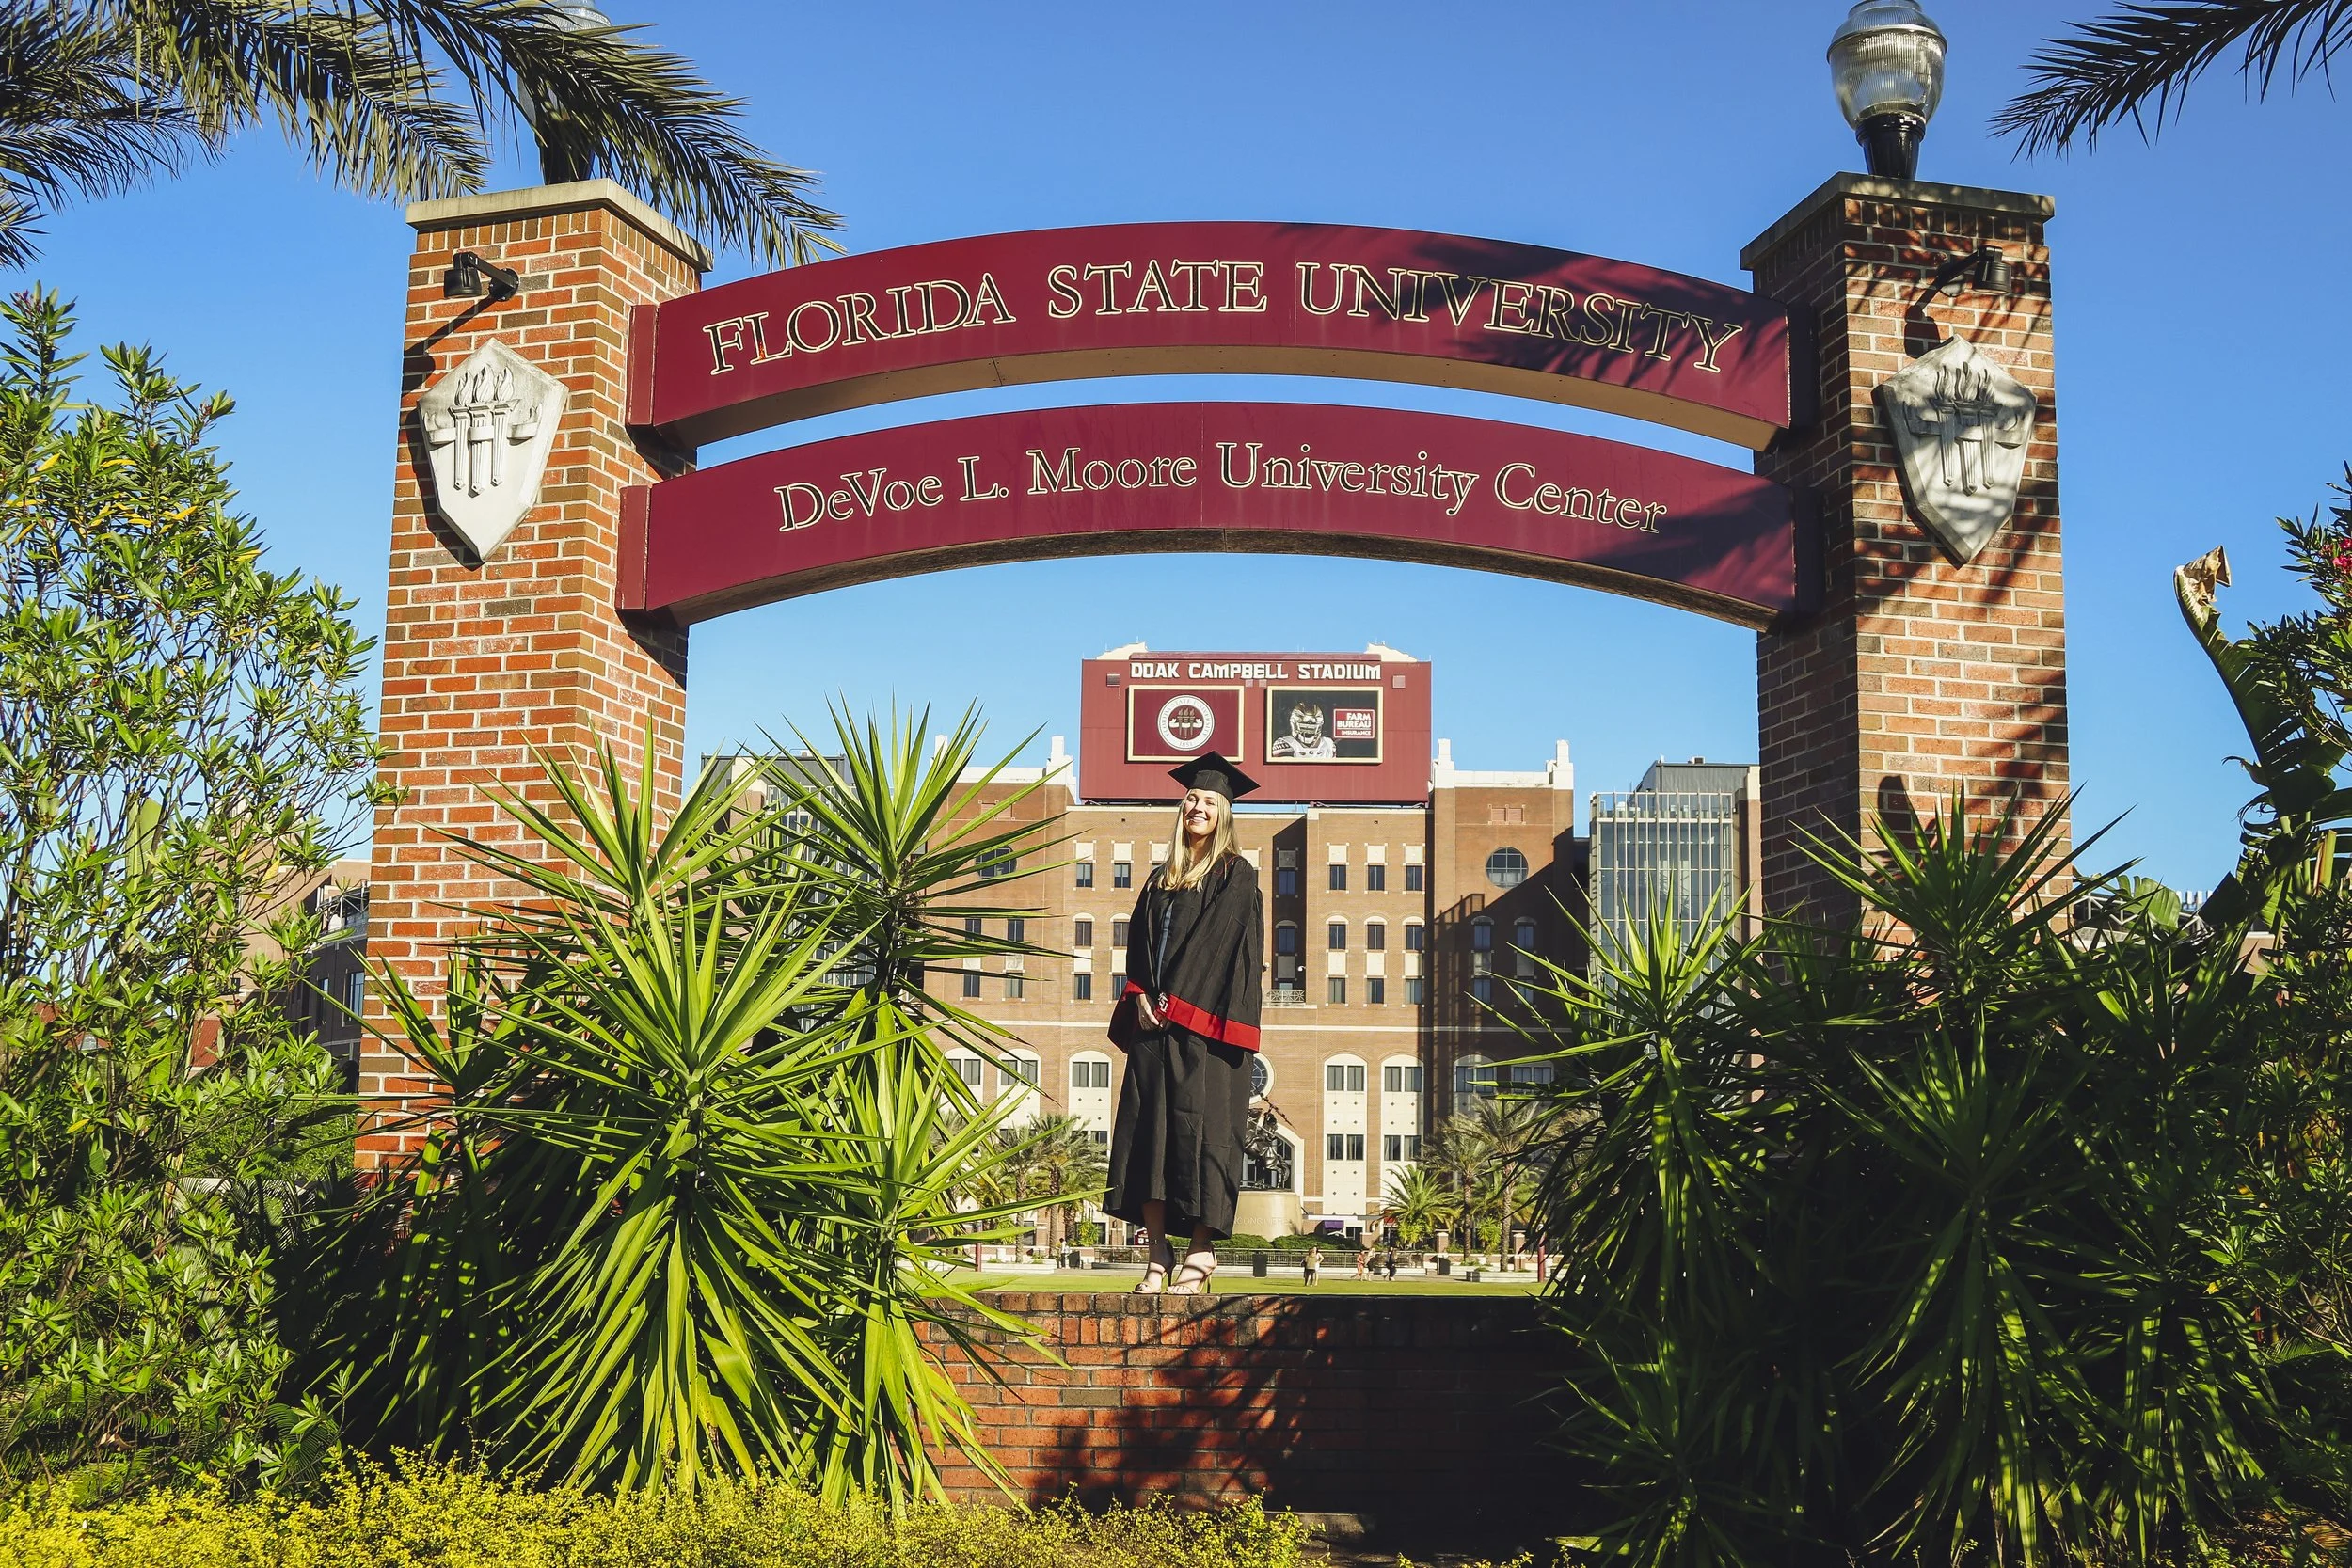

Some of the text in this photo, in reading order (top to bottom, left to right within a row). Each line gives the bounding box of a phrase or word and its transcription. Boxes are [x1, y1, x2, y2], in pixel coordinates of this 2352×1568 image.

[702, 259, 1742, 376] FLORIDA STATE UNIVERSITY
[773, 441, 1668, 534] DeVoe L. Moore University Center
[1130, 662, 1381, 680] DOAK CAMPBELL STADIUM
[1337, 720, 1372, 728] BUREAU
[1346, 712, 1372, 721] FARM
